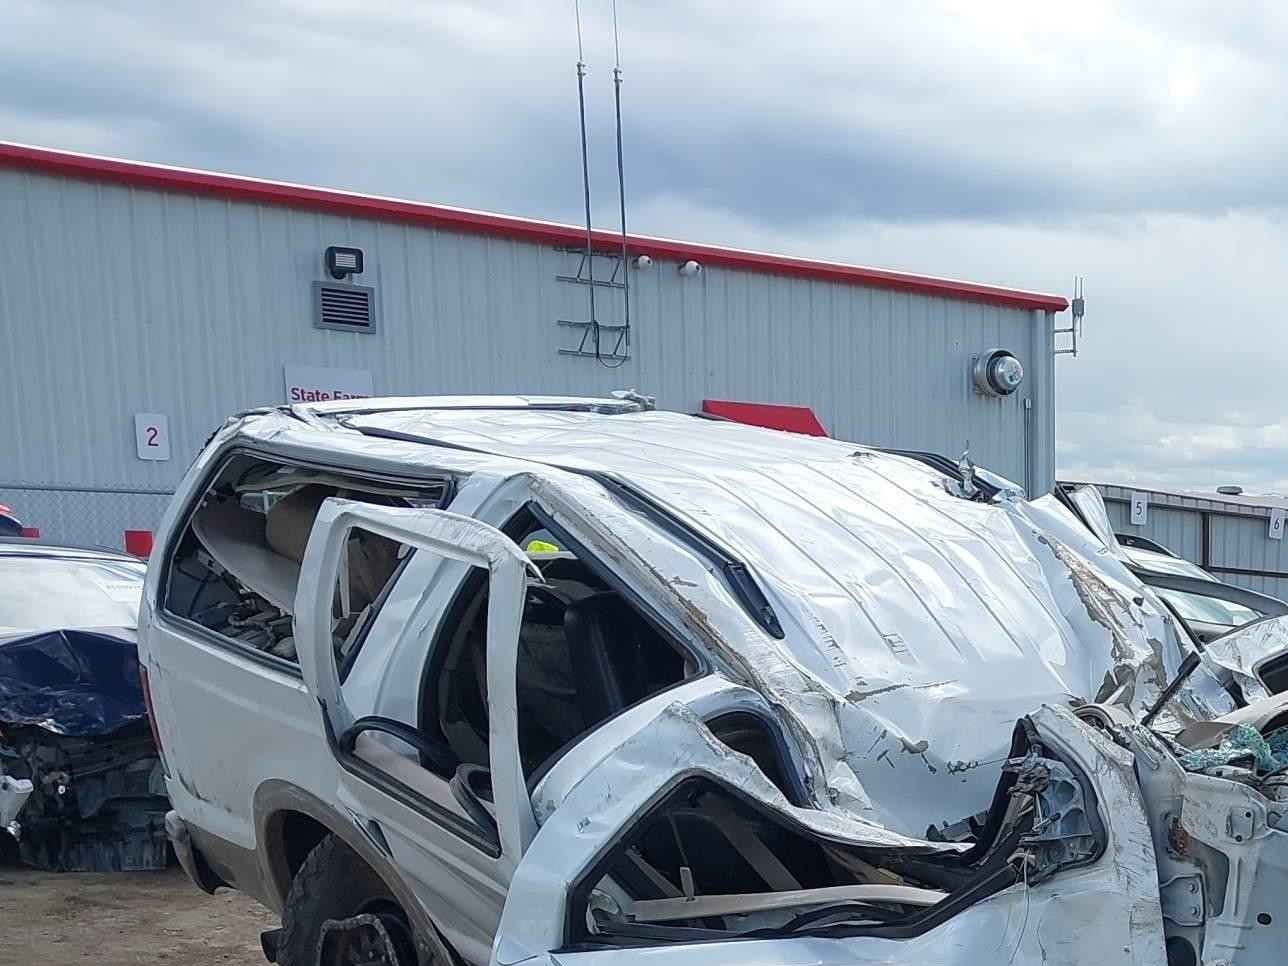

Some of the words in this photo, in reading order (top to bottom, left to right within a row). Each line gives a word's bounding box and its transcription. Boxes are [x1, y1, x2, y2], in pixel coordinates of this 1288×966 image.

[291, 387, 330, 402] State
[146, 427, 159, 447] 2
[1136, 501, 1143, 516] 5
[1273, 518, 1280, 530] 6
